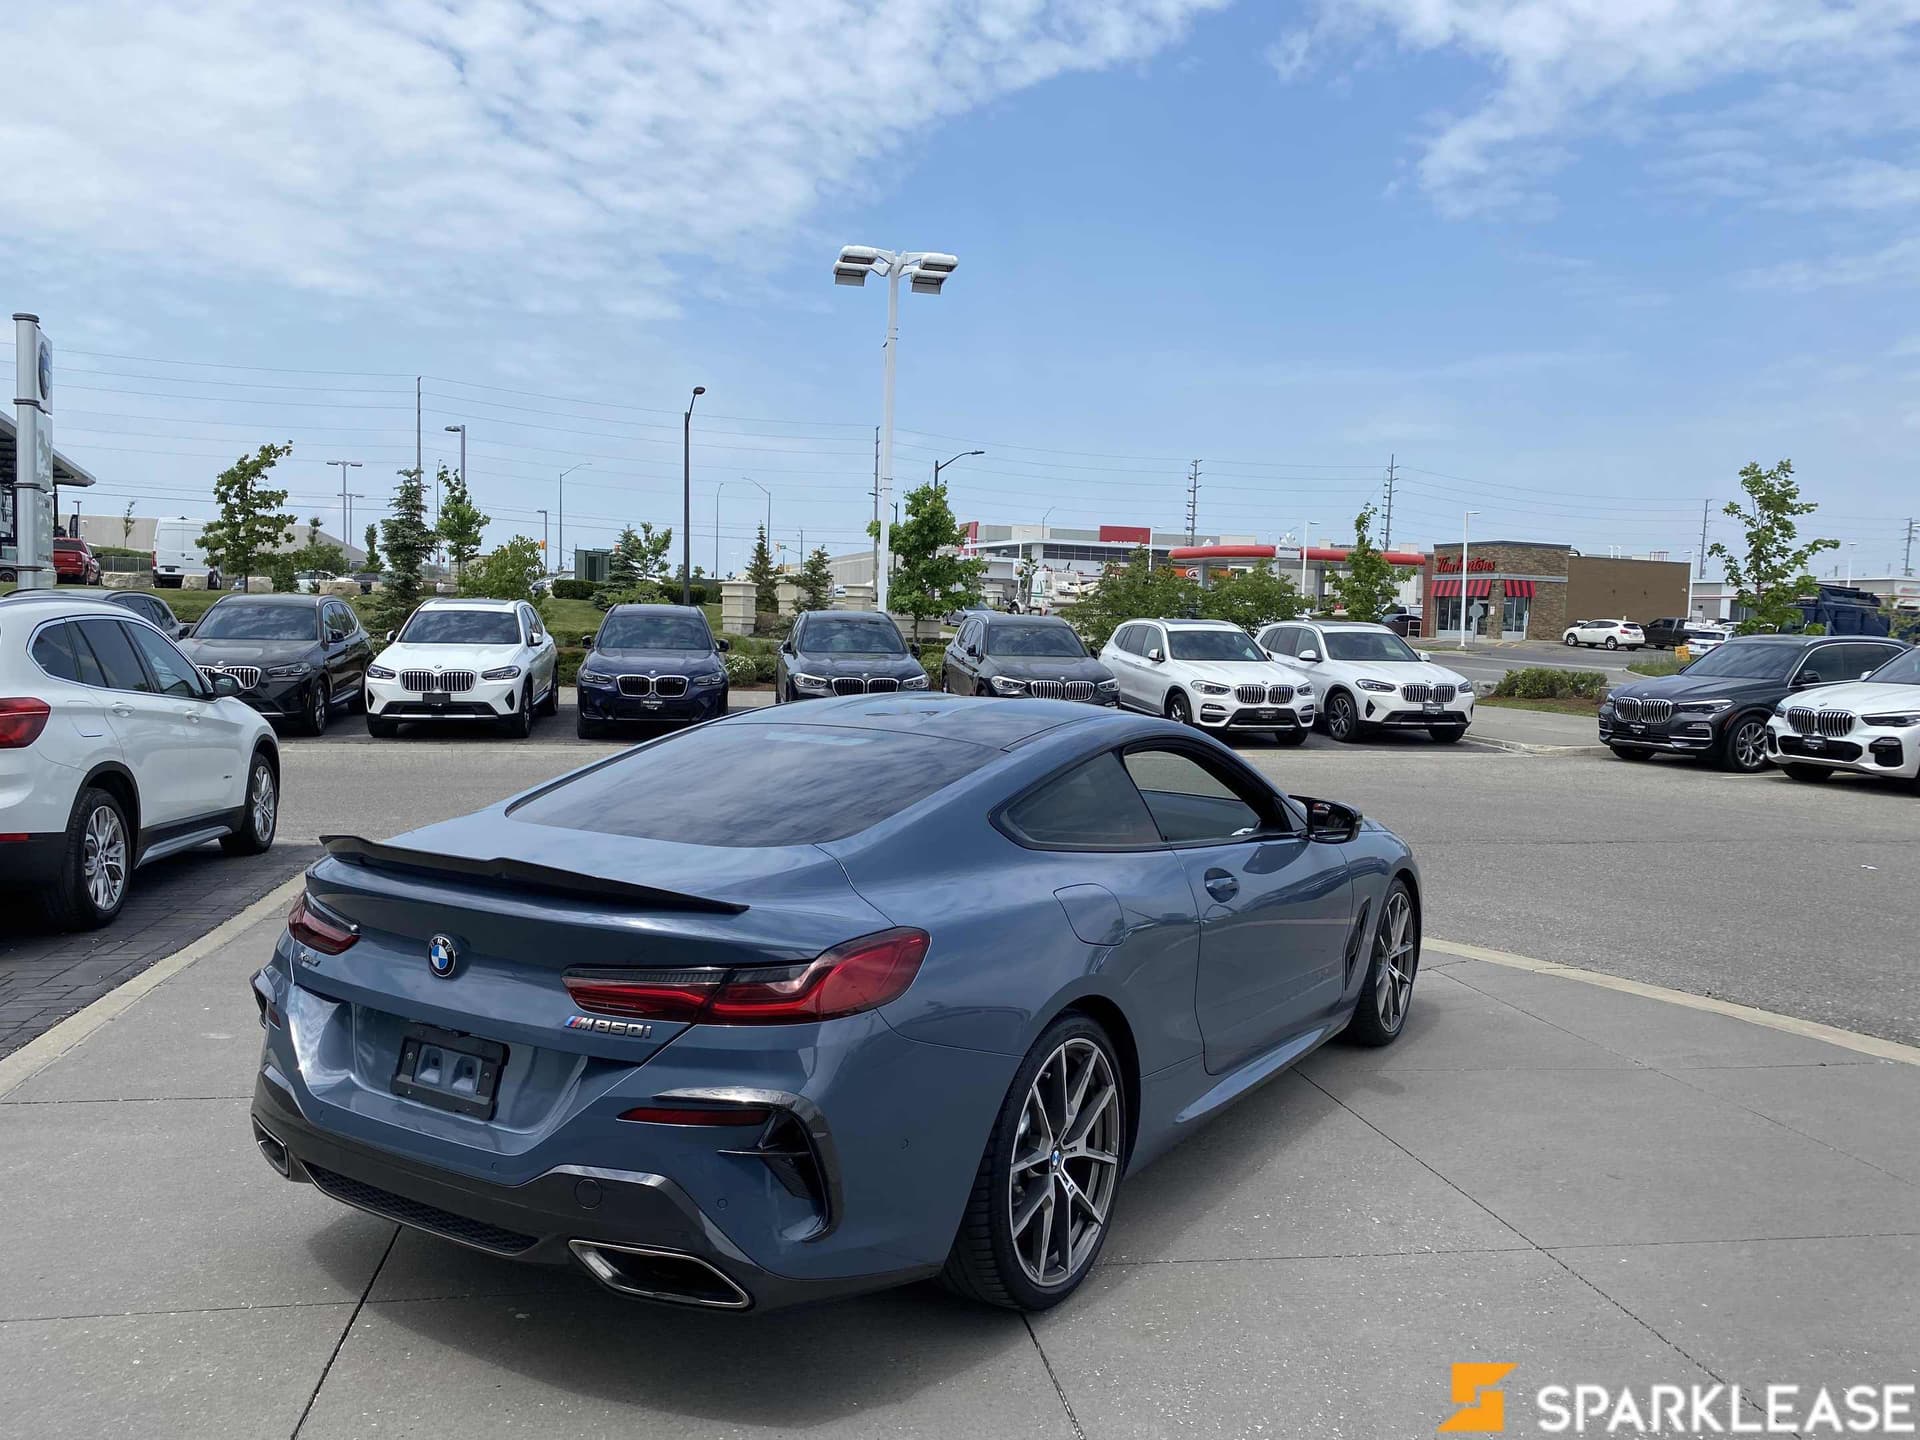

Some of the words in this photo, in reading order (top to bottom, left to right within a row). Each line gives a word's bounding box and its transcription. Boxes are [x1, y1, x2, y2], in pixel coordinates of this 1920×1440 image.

[1437, 556, 1455, 572] Tim
[1456, 553, 1496, 571] Hrtons
[575, 1017, 653, 1038] M850i
